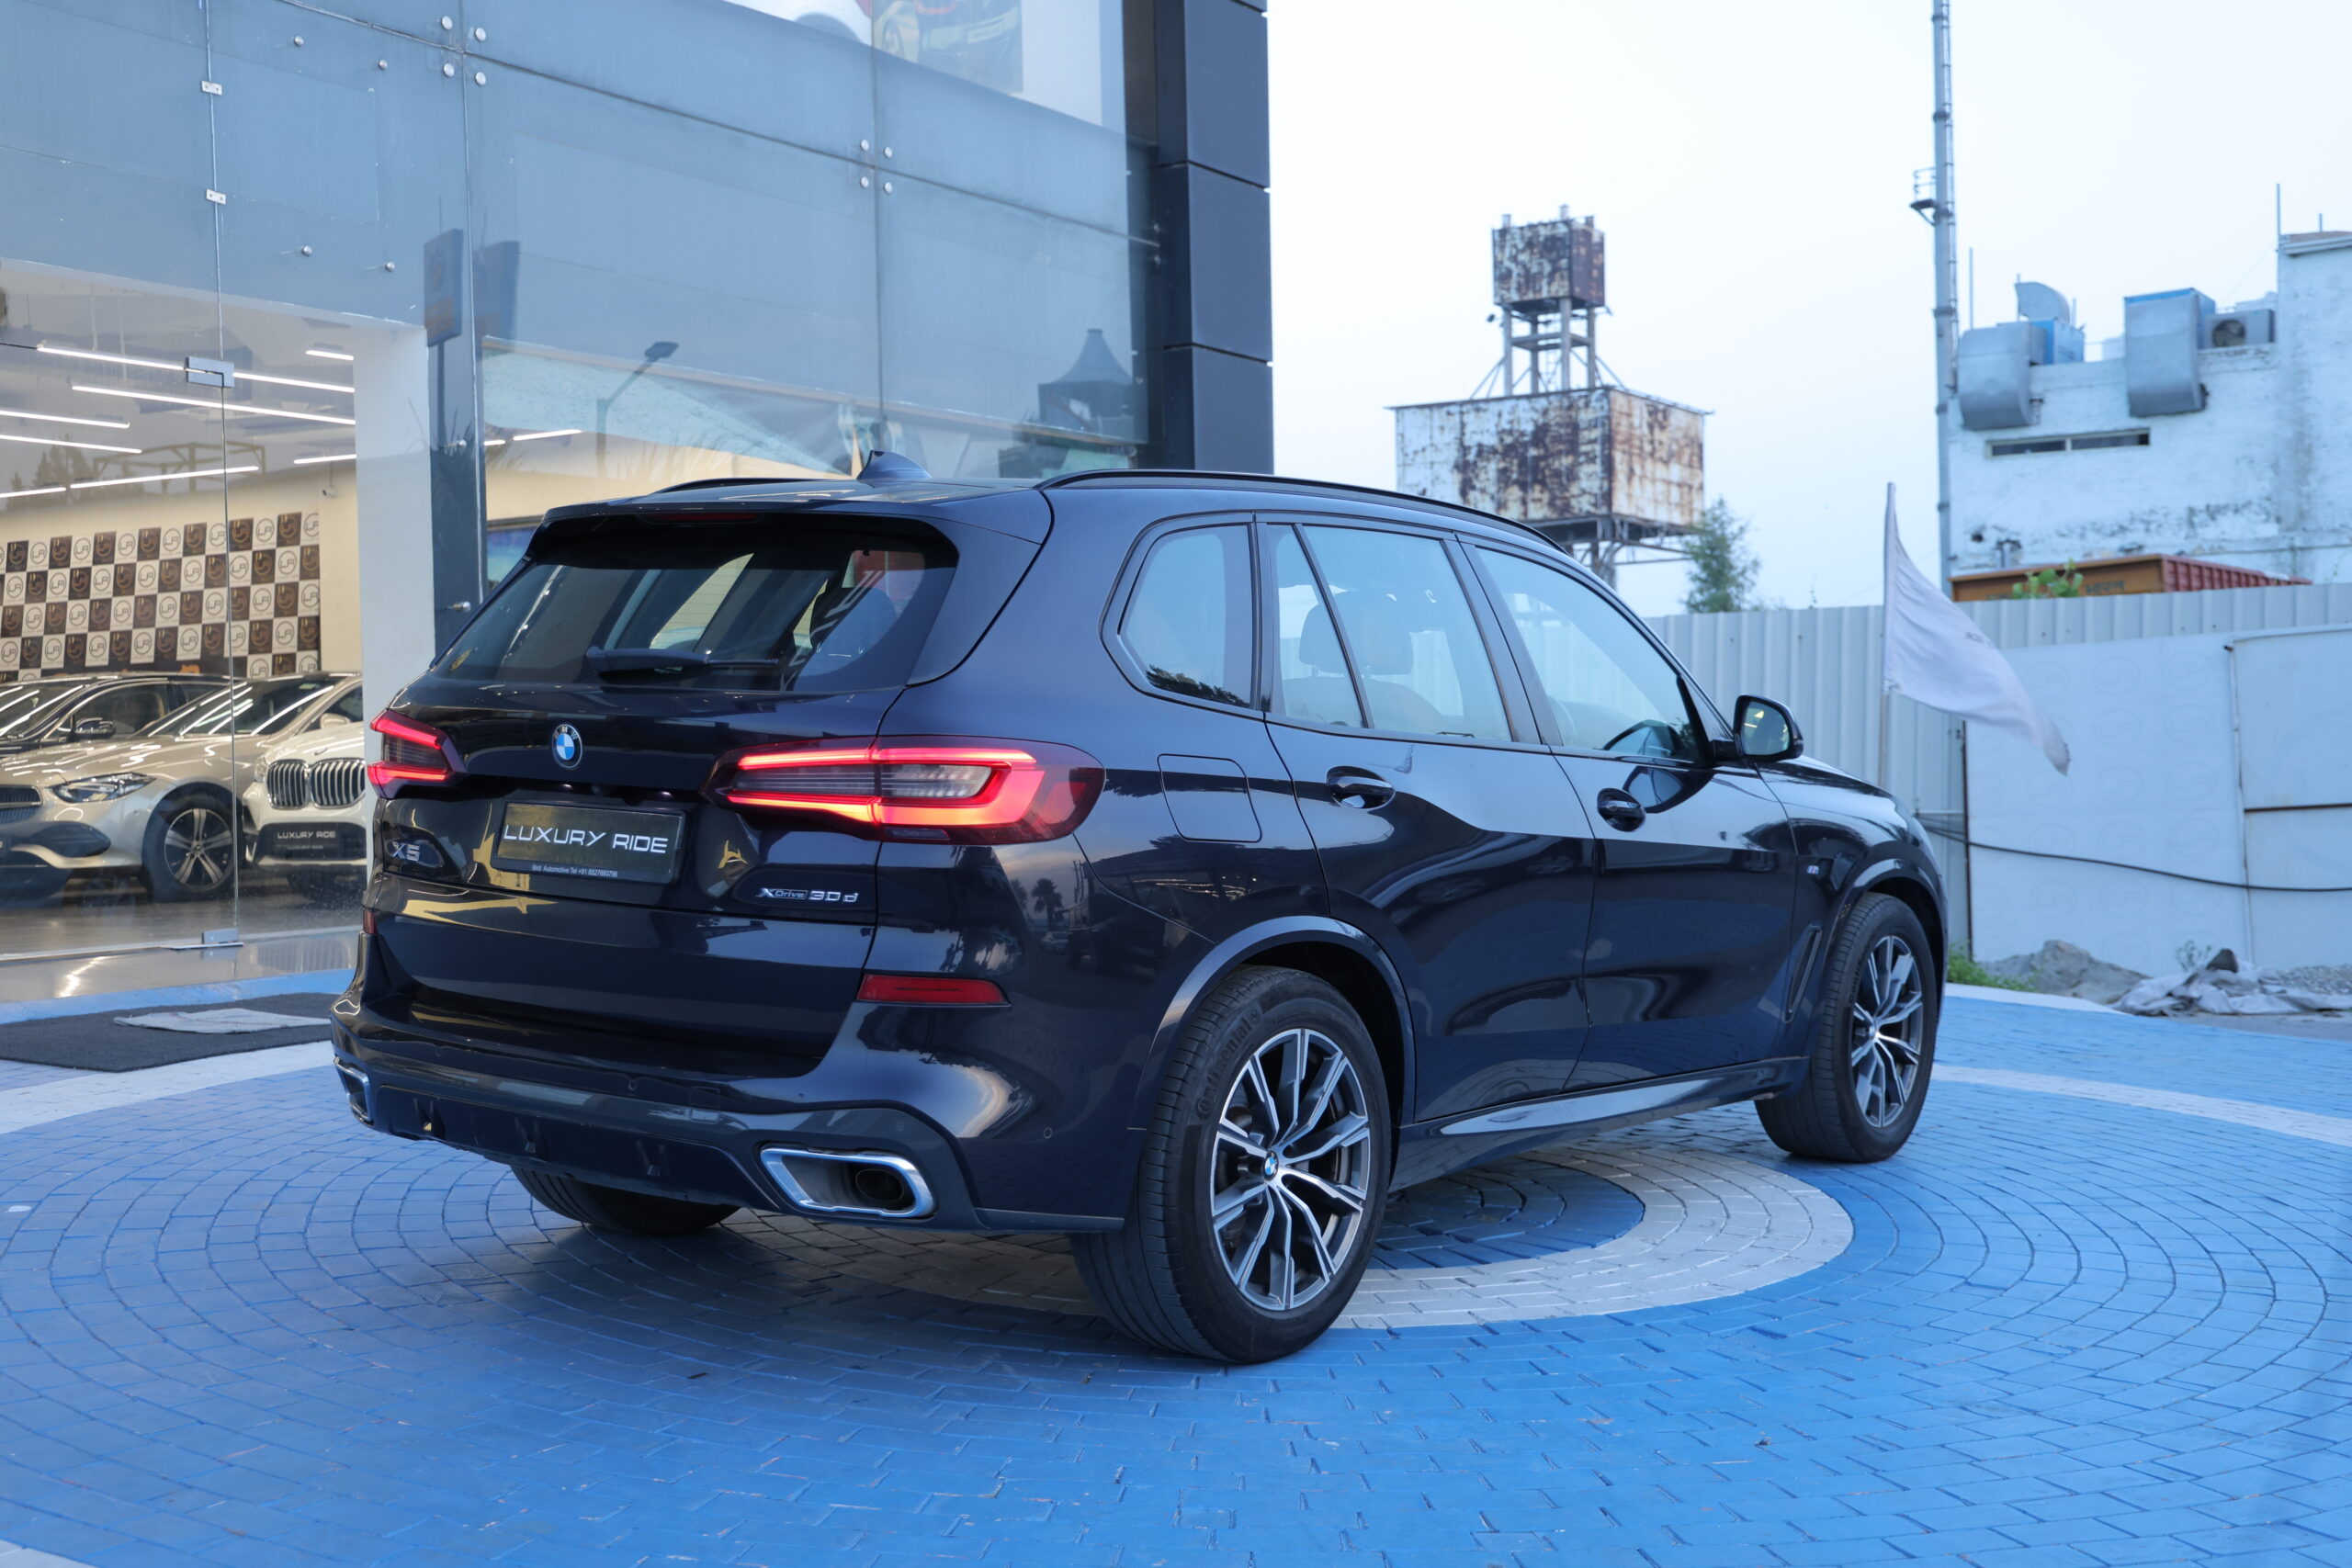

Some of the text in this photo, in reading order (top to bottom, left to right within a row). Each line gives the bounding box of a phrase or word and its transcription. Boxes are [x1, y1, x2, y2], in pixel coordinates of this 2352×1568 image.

[277, 830, 314, 840] LUXURY
[503, 825, 669, 854] LUXURY RIDE
[392, 841, 420, 862] X5
